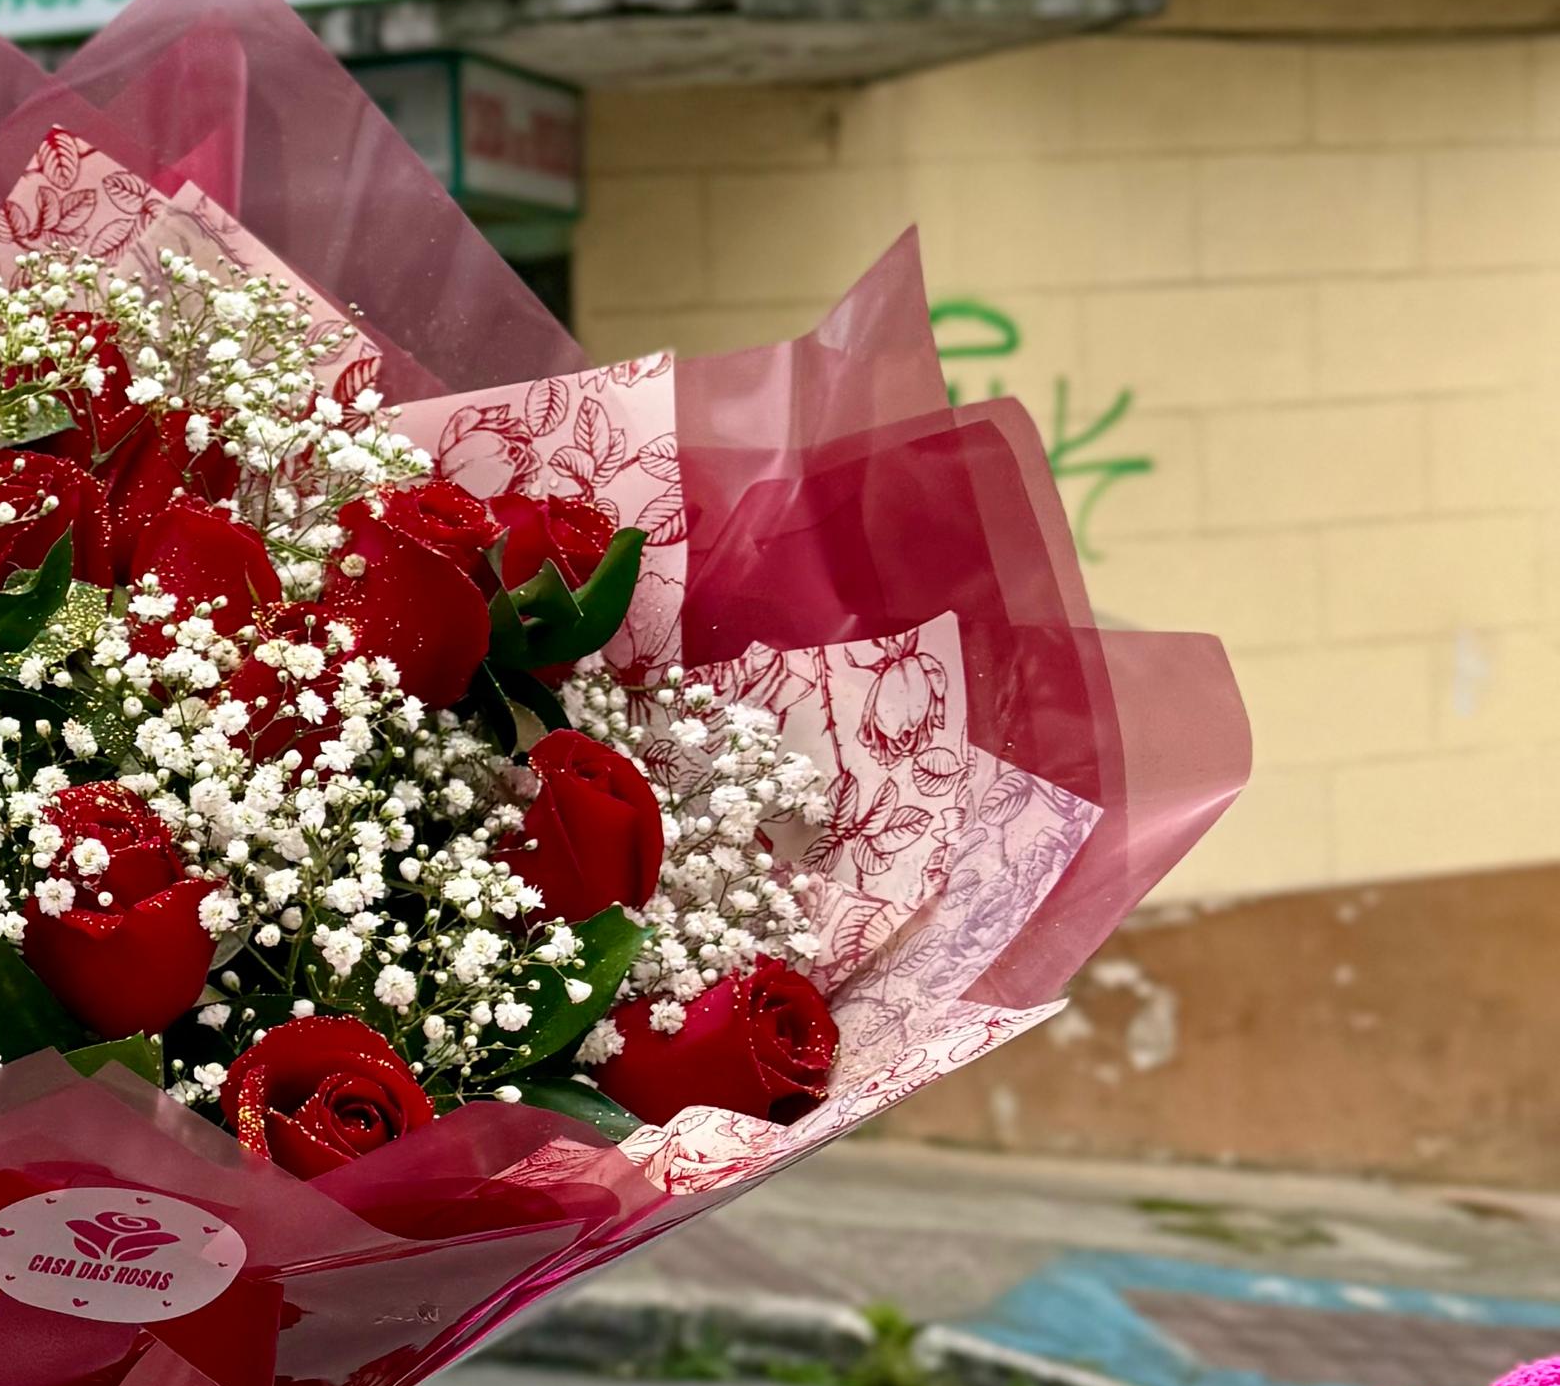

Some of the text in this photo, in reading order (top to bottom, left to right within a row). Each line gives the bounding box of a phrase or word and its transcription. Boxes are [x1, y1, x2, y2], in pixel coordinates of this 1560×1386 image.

[27, 1254, 174, 1291] CASA DAS ROSAS
